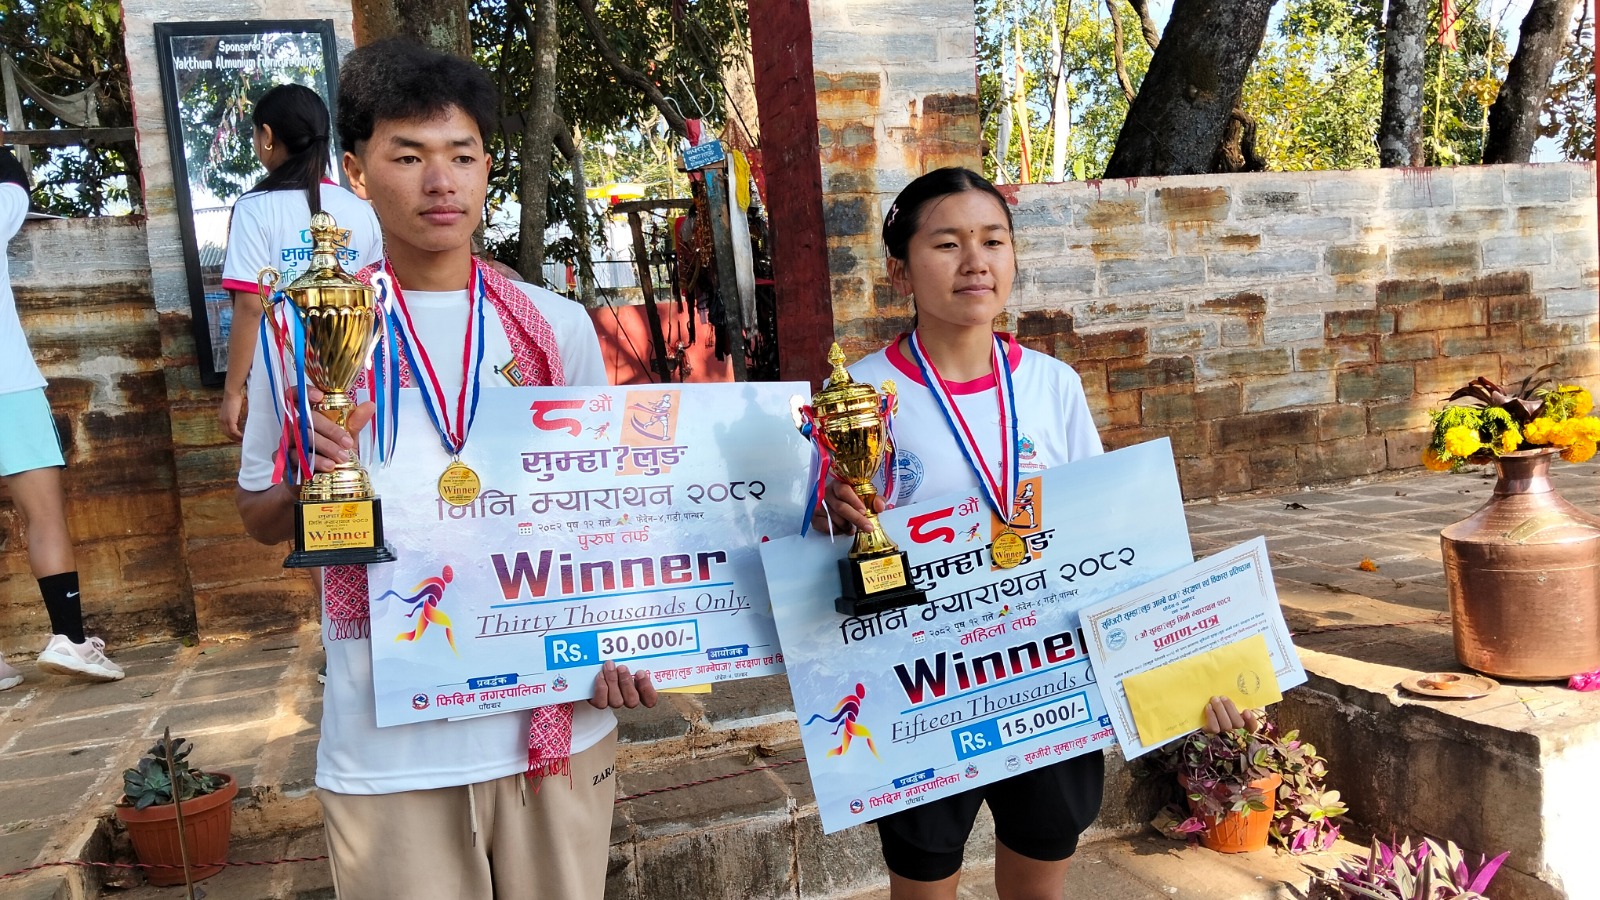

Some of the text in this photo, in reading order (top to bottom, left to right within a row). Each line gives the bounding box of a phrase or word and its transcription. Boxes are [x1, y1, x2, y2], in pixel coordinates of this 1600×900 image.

[173, 56, 212, 72] Yakthum
[218, 41, 260, 55] Sponsered
[521, 444, 688, 482] सुम्हा?लुङ
[443, 485, 477, 495] Winner
[529, 483, 675, 514] म्याराथन
[686, 480, 766, 504] २०८२
[308, 530, 370, 542] Winner
[538, 520, 563, 533] २०८२
[598, 517, 611, 528] गते
[577, 525, 652, 550] पुरुष तर्फ
[995, 550, 1023, 560] Winner
[490, 549, 727, 600] Winner
[865, 571, 903, 585] Winner
[921, 568, 1048, 622] म्याराथन
[1059, 547, 1136, 583] २०८२
[476, 589, 751, 638] Thirty Thousands Only.
[960, 610, 1038, 646] महिला तर्फ
[1153, 613, 1220, 649] प्रमाण-पत्र
[552, 626, 695, 664] Rs. 30,000/-
[436, 683, 547, 709] फिदिम नगरपालिका
[890, 709, 963, 744] Fifteen
[967, 672, 1077, 717] Thousands
[958, 730, 992, 754] Rs.
[1002, 699, 1085, 738] 15,000/-
[868, 773, 961, 810] फिदिम नगरपालिका
